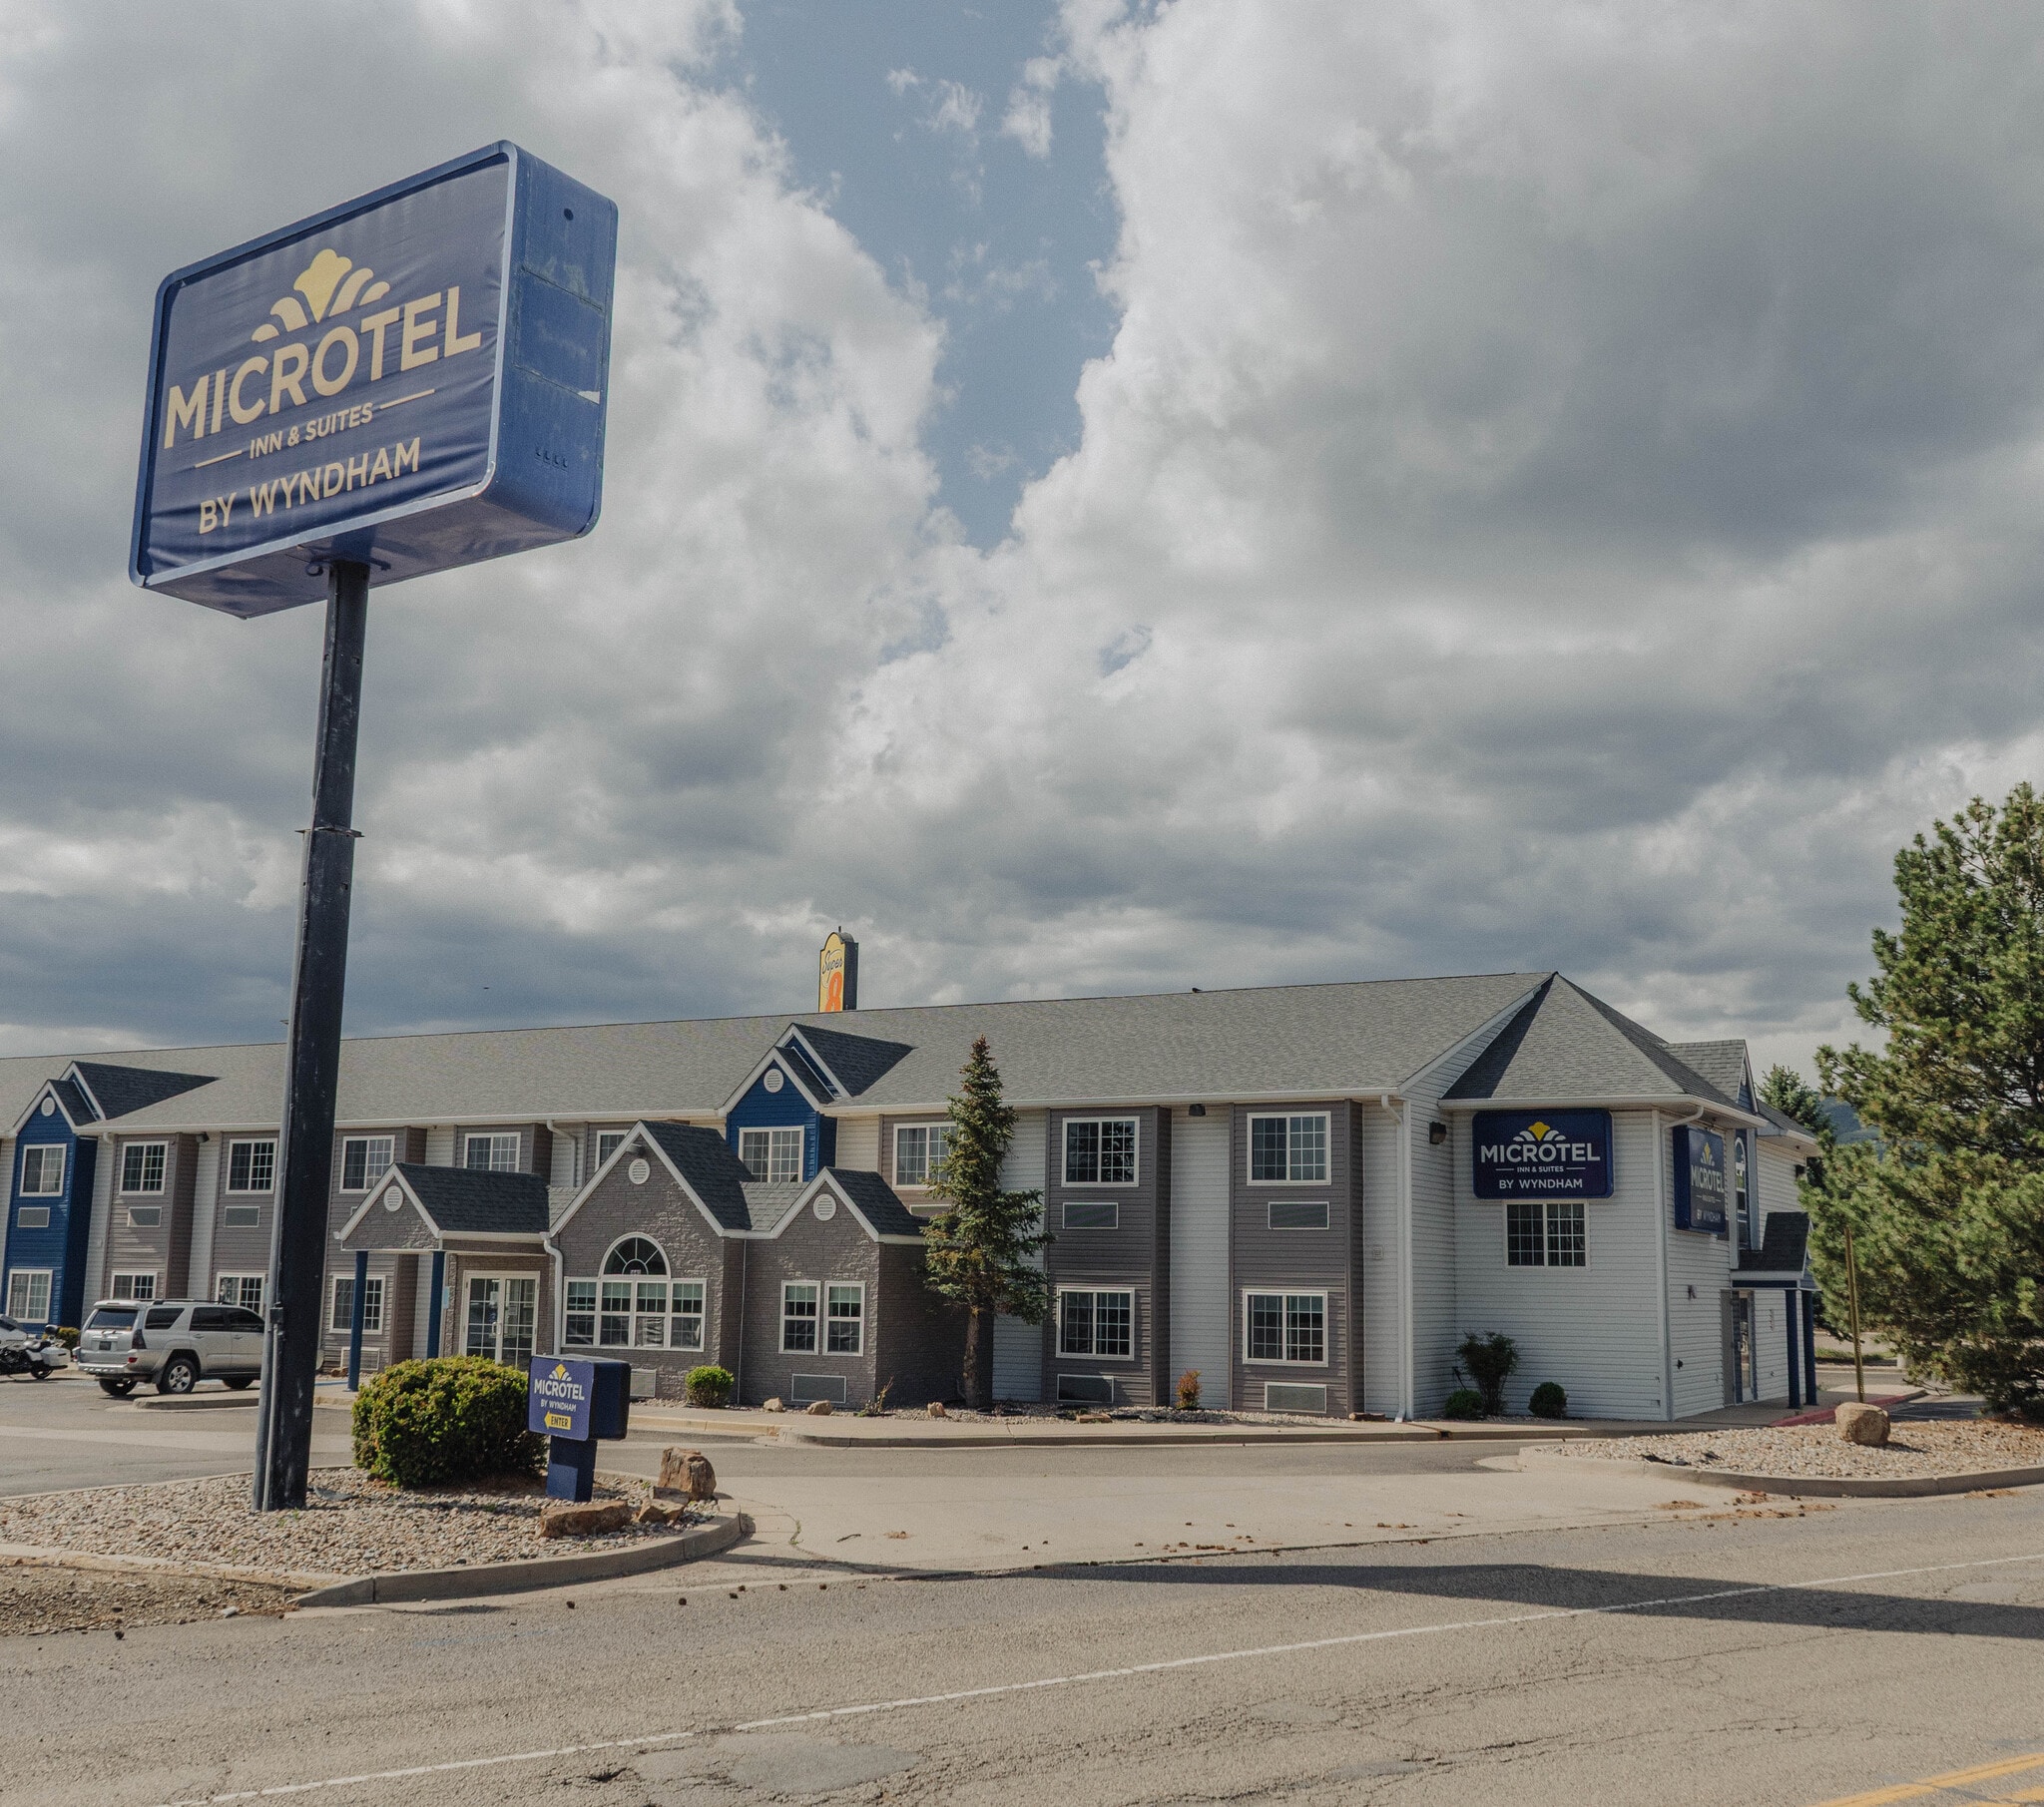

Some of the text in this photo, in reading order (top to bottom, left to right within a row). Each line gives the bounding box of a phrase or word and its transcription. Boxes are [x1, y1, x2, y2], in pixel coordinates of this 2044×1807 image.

[163, 285, 482, 449] MICROTEL
[250, 401, 373, 459] INN & SUITES
[199, 436, 421, 535] BY WYNDHAM
[1480, 1142, 1601, 1163] MICROTEL
[1499, 1178, 1583, 1189] BY WYNDHAM
[1691, 1164, 1725, 1193] MICROTEL
[534, 1379, 585, 1400] MICROTEL
[549, 1401, 576, 1412] WYNDHAM
[551, 1416, 568, 1426] ENTER
